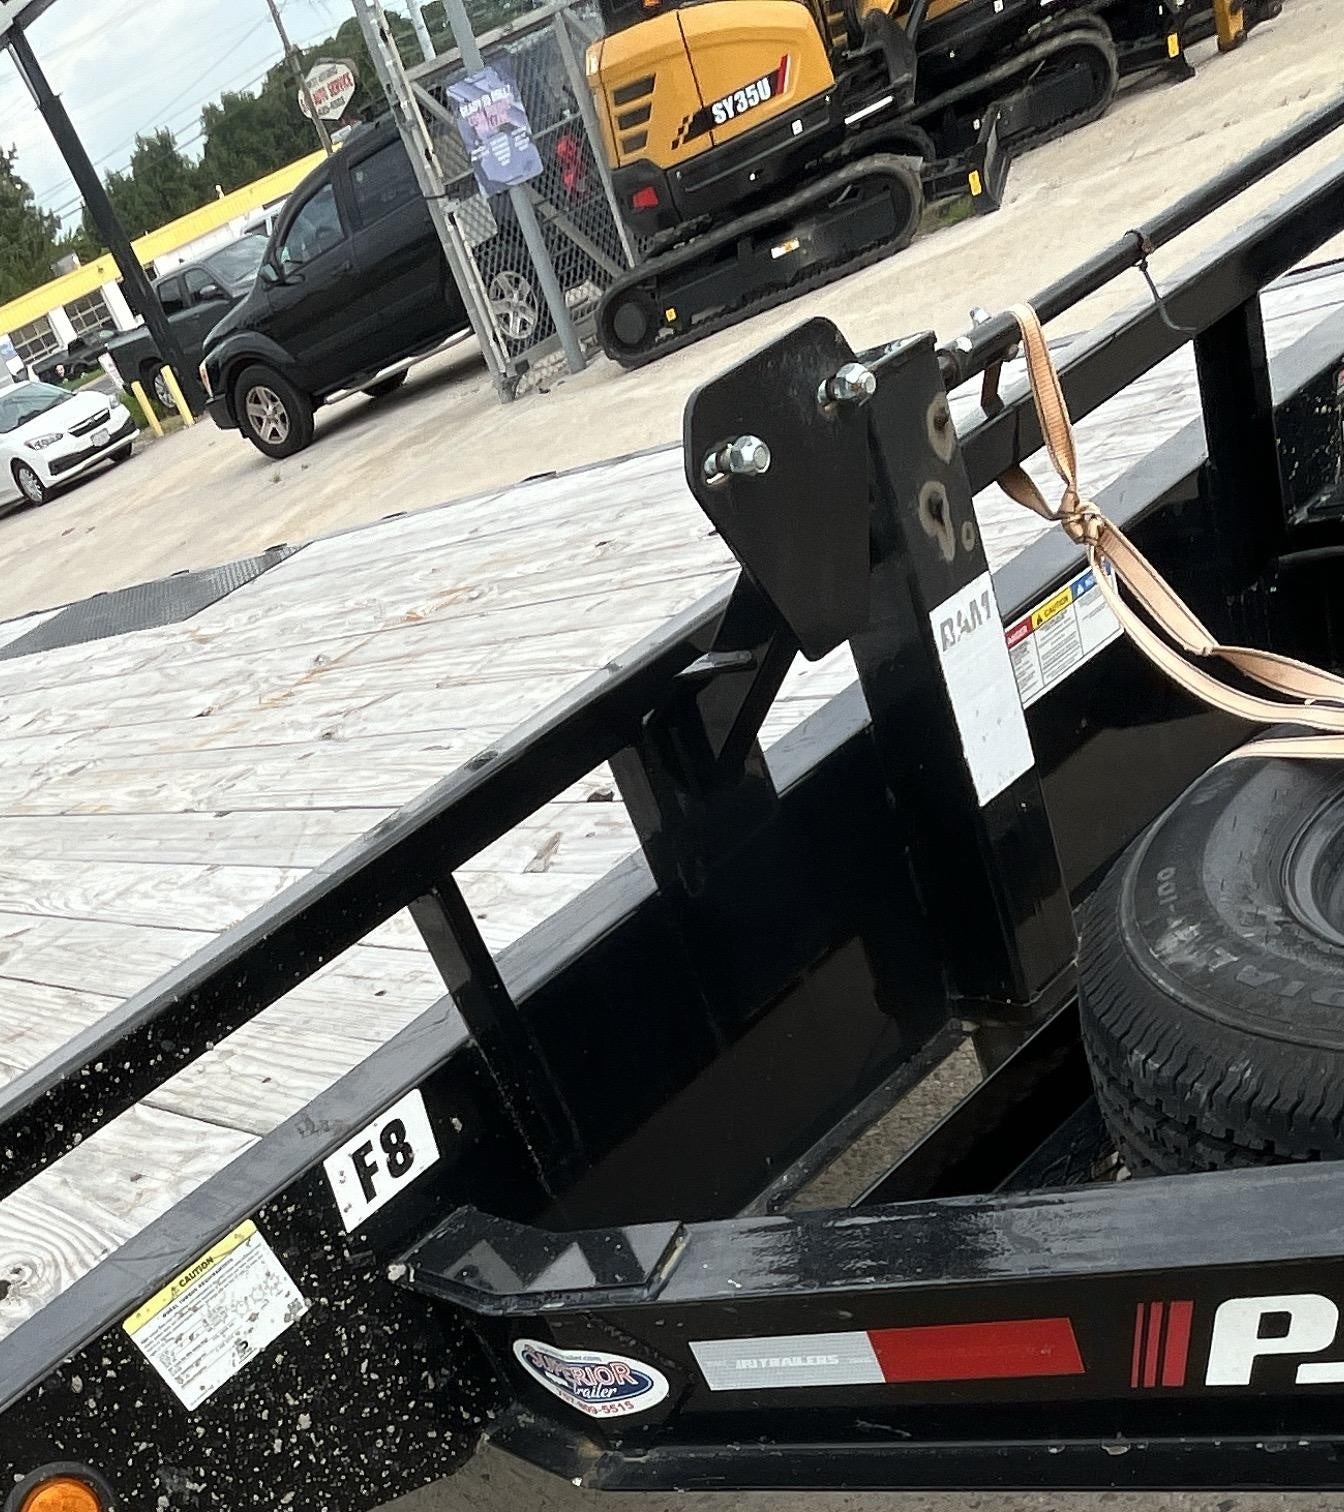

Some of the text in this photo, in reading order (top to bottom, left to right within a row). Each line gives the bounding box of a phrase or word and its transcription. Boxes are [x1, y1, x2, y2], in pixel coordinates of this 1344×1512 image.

[711, 77, 771, 124] SY35U
[351, 1118, 415, 1204] F8
[179, 1256, 215, 1287] CAUTION
